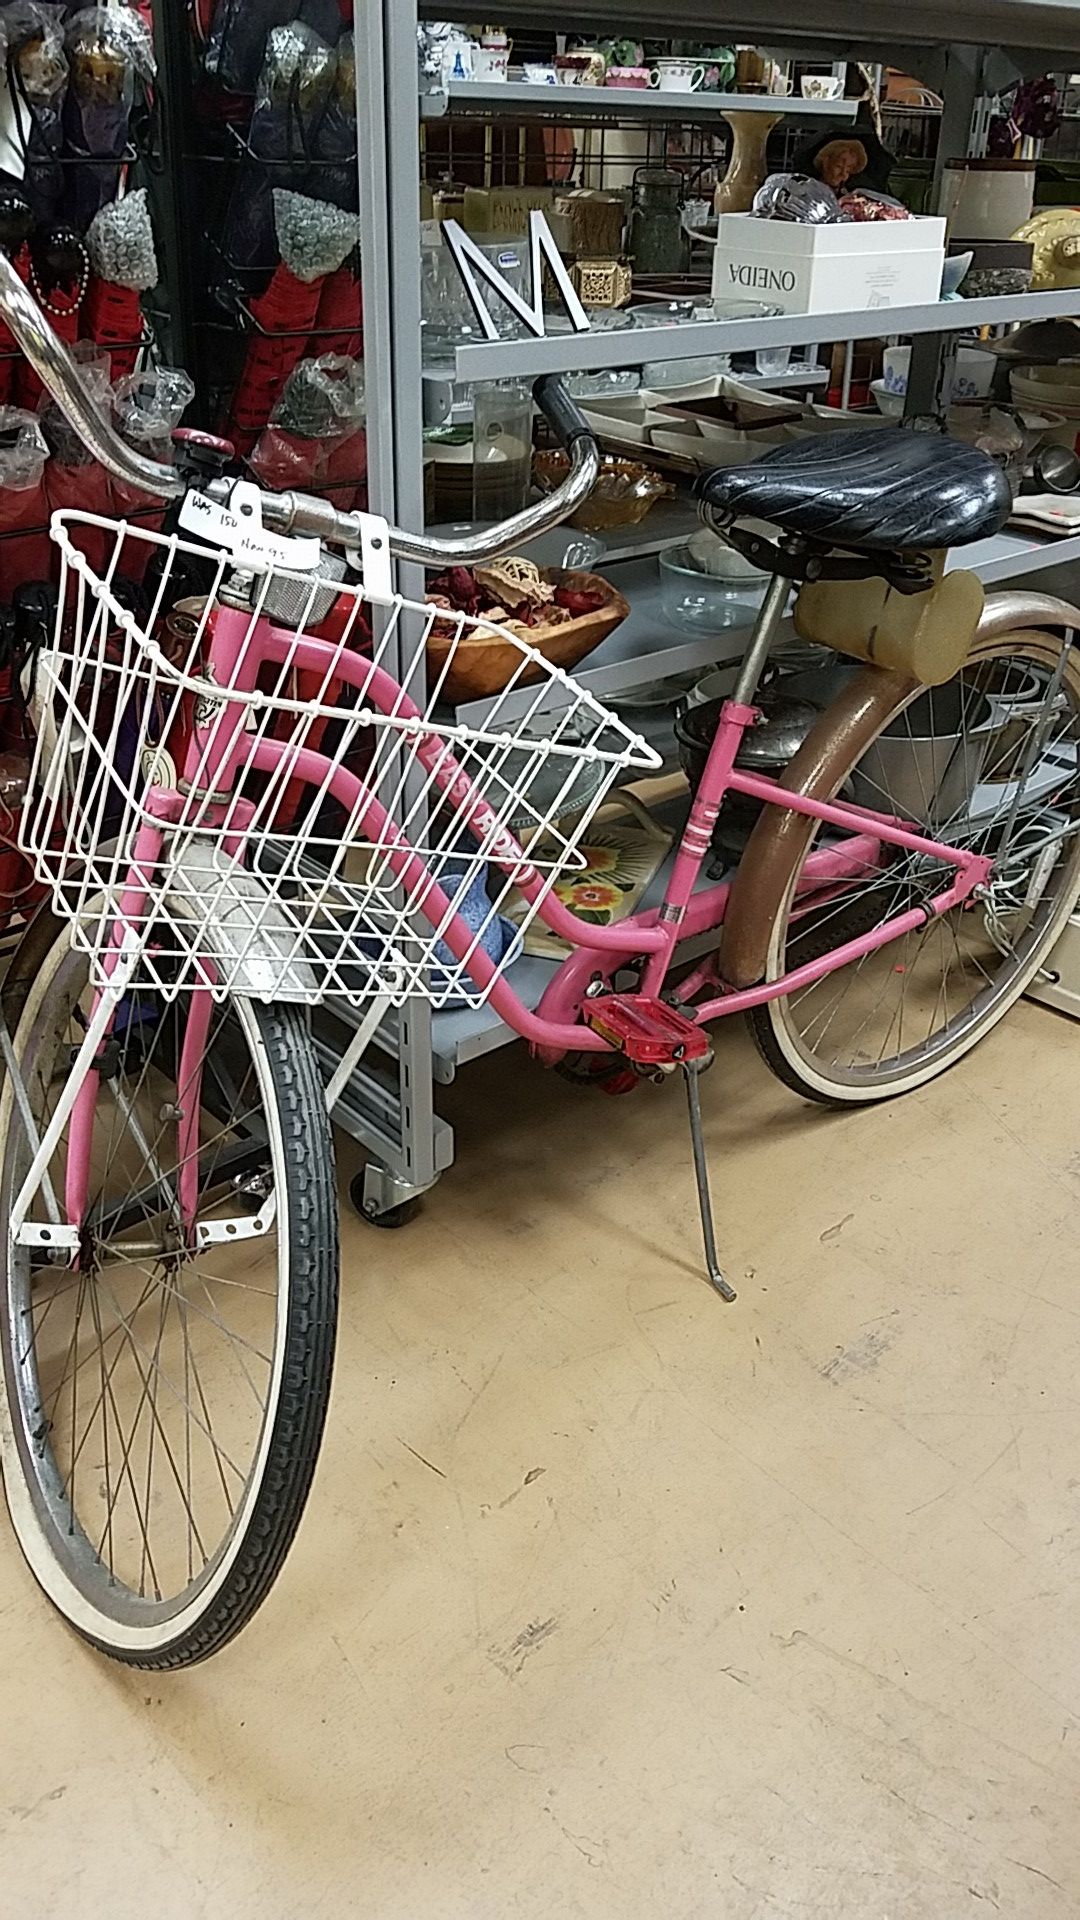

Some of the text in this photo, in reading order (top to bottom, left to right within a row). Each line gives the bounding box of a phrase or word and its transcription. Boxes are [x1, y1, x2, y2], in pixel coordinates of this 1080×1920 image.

[729, 264, 796, 292] ONEIDA
[425, 748, 524, 863] EAS RDE
